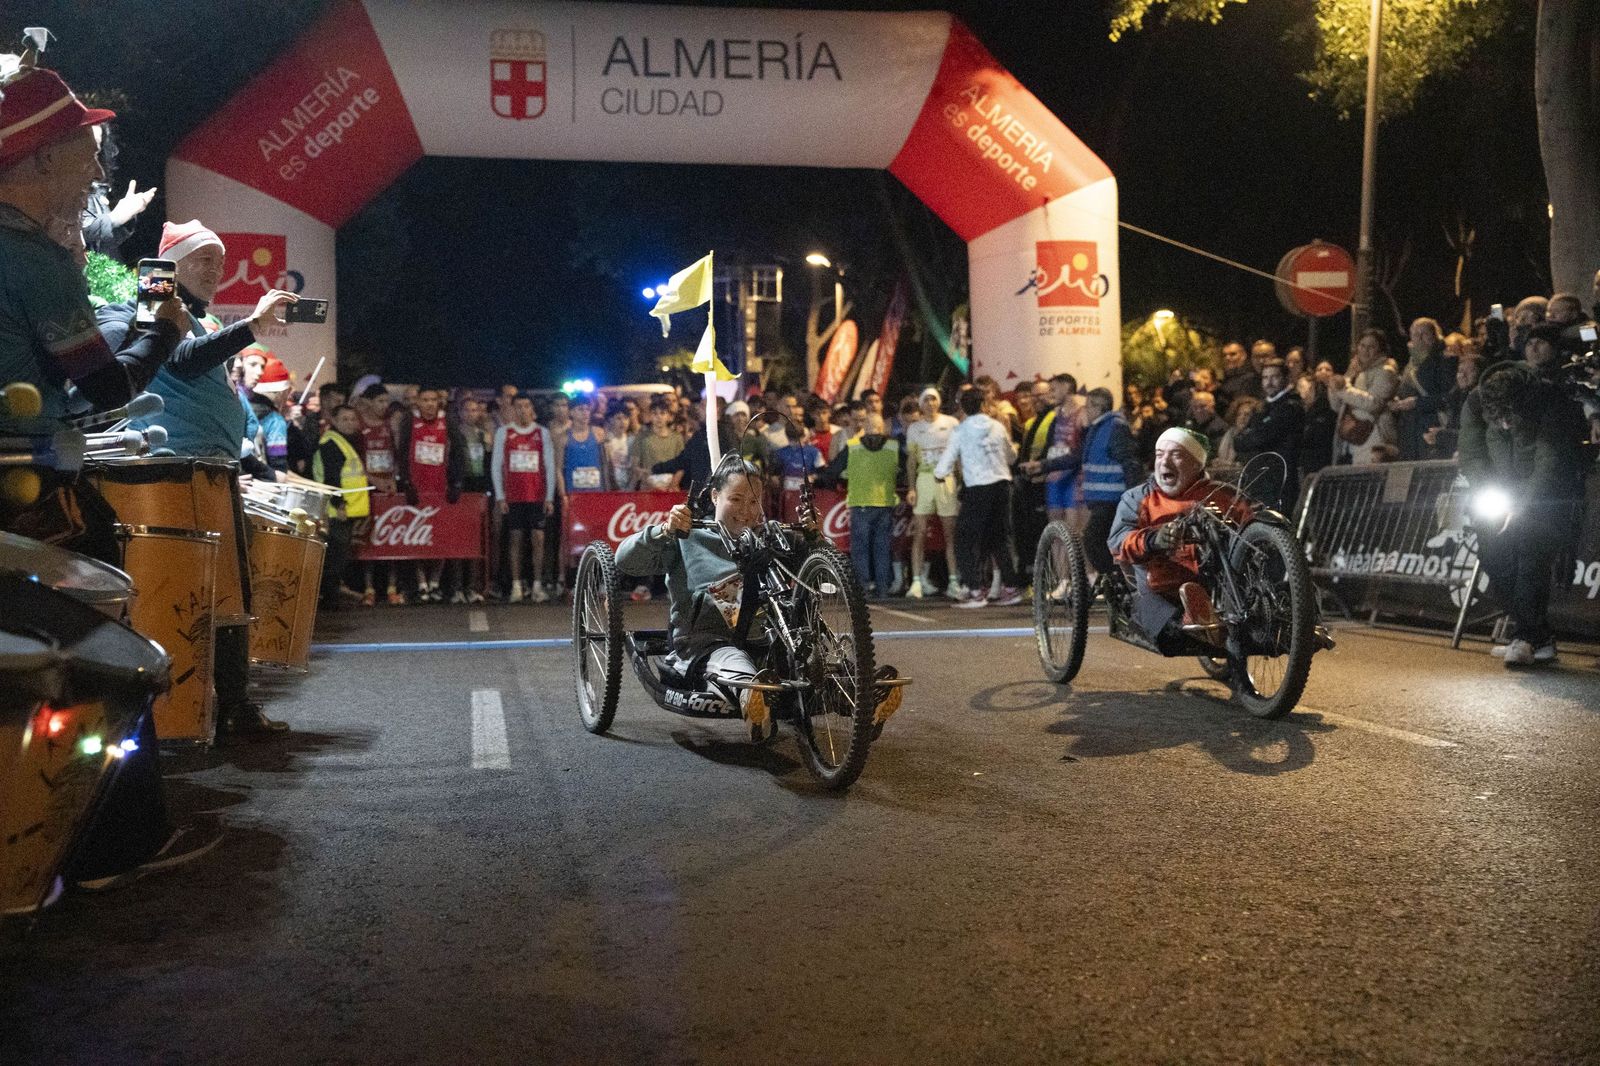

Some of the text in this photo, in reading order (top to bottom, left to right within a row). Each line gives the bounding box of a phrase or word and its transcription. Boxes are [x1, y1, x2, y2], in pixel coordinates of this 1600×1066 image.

[602, 32, 843, 81] ALMERÍA
[258, 66, 361, 162] ALMERÍA
[280, 87, 380, 180] es deporte
[601, 87, 724, 117] CIUDAD
[960, 84, 1054, 174] ALMERÍA
[943, 102, 1038, 192] es deporte
[1039, 315, 1101, 326] DEPORTES
[1040, 327, 1054, 336] DE
